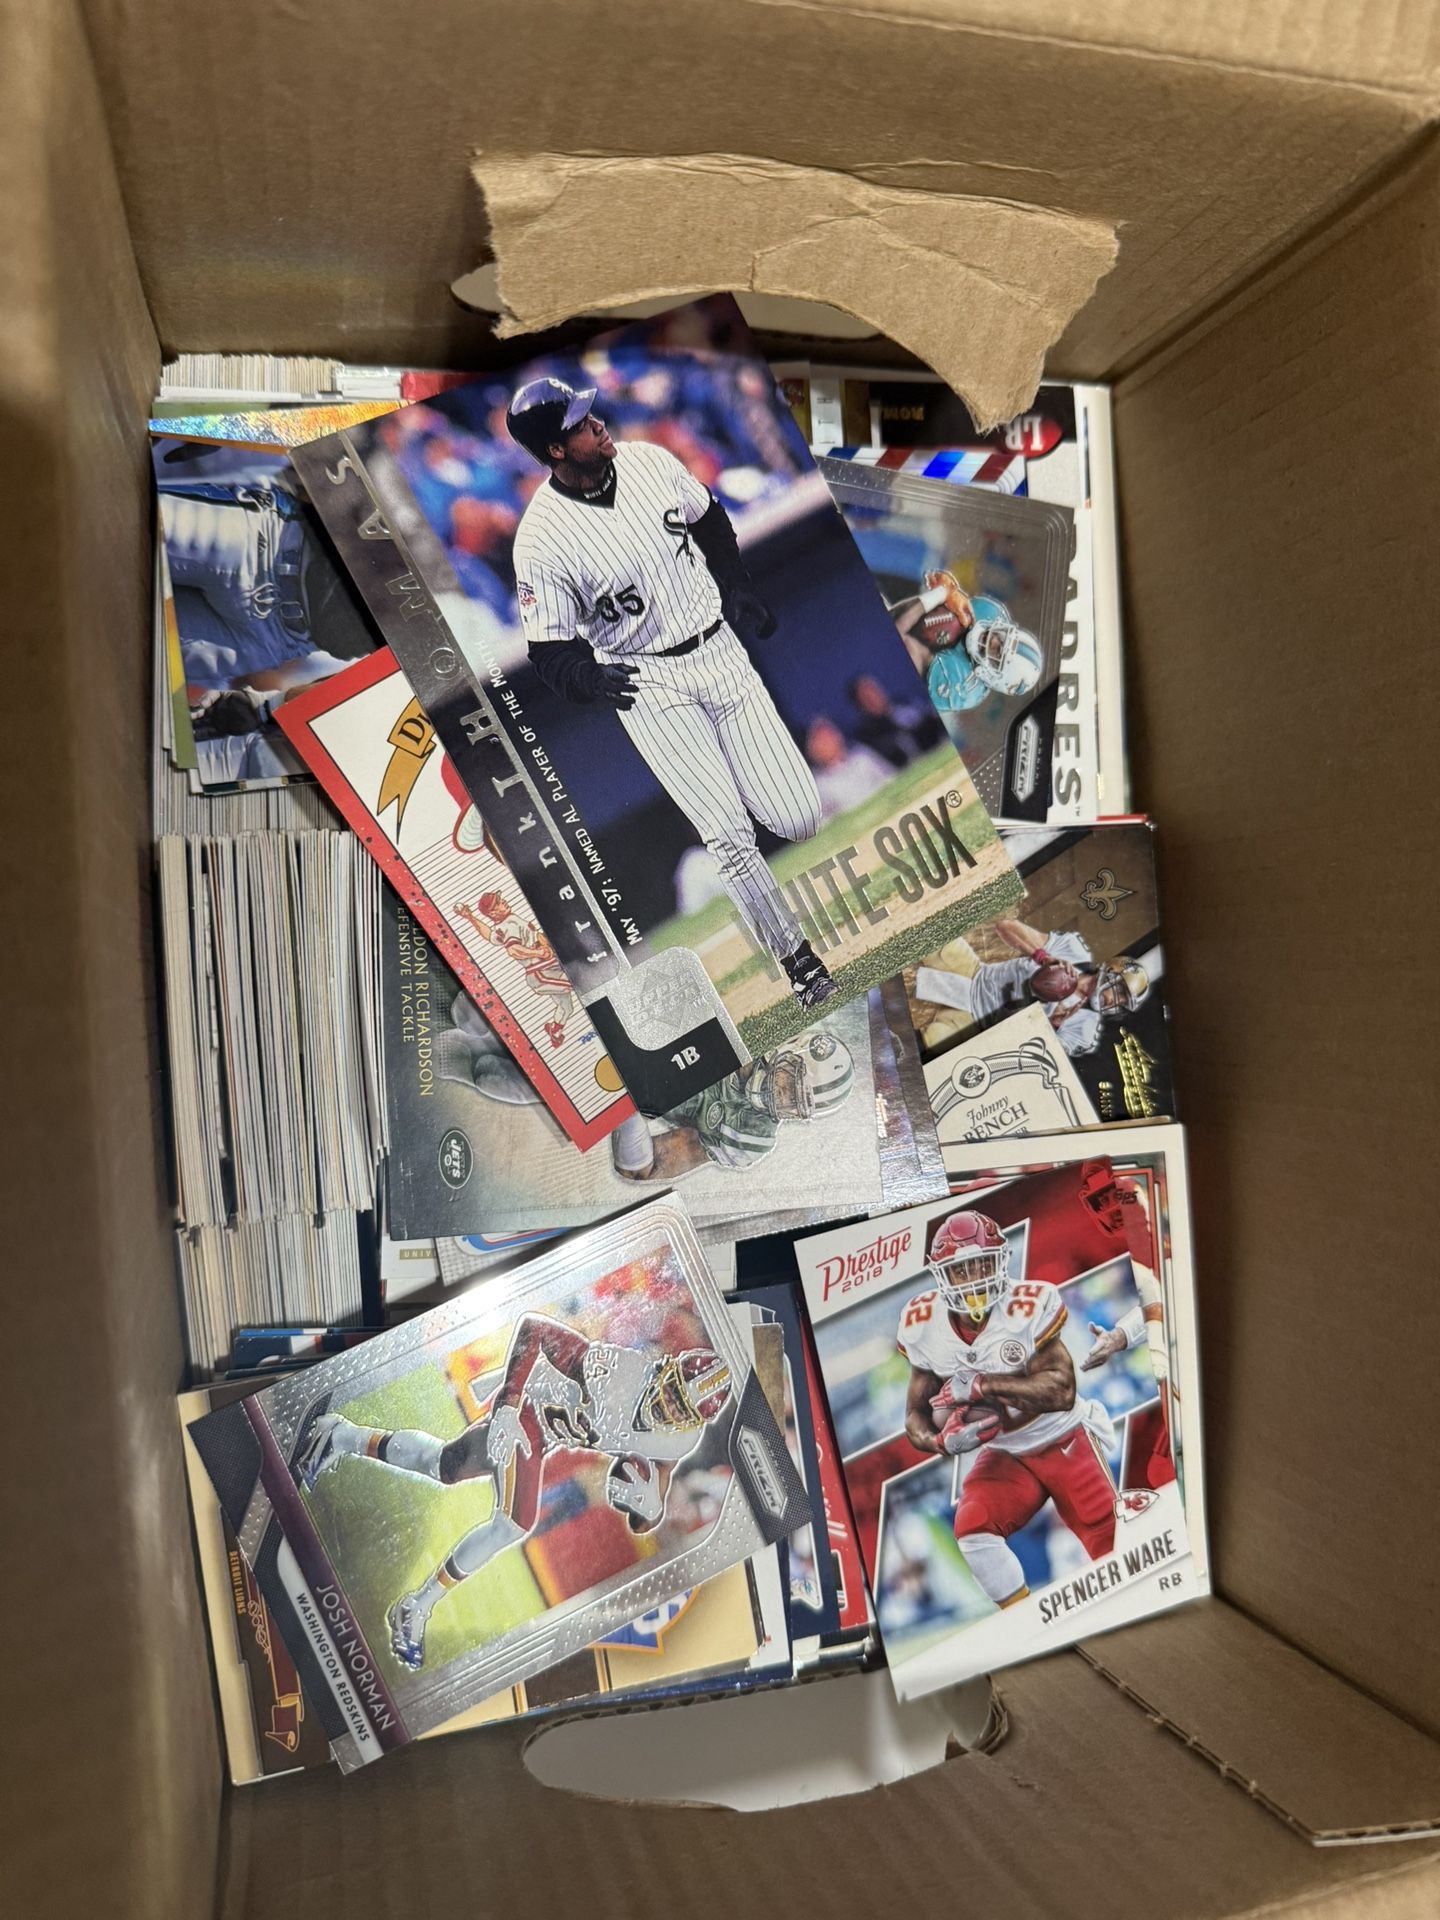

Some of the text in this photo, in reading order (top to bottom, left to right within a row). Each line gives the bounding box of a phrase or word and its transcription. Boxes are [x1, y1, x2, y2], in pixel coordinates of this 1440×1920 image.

[595, 583, 646, 623] 35
[474, 640, 508, 688] MONTH
[501, 688, 524, 720] THE
[519, 725, 537, 744] OF
[532, 745, 566, 802] PLAYER
[1018, 724, 1032, 795] PRIZM
[563, 804, 580, 824] AL
[574, 828, 605, 874] NAMED
[620, 917, 643, 946] MAY
[401, 983, 415, 1043] TACKLE
[414, 981, 434, 1097] RICHARDSON
[670, 1045, 701, 1071] 1B
[966, 1093, 1009, 1124] Johnny
[449, 1139, 462, 1179] JETS
[816, 1226, 912, 1302] Prestige
[842, 1265, 883, 1293] 2018
[744, 1436, 781, 1509] PRIZM
[229, 1550, 247, 1615] DETROIT LIONS
[1038, 1529, 1177, 1624] SPENCER WARE
[1158, 1572, 1183, 1591] RB
[296, 1592, 370, 1742] WASHINGTON REDSKINS
[317, 1584, 396, 1730] JOSH NORMAN
